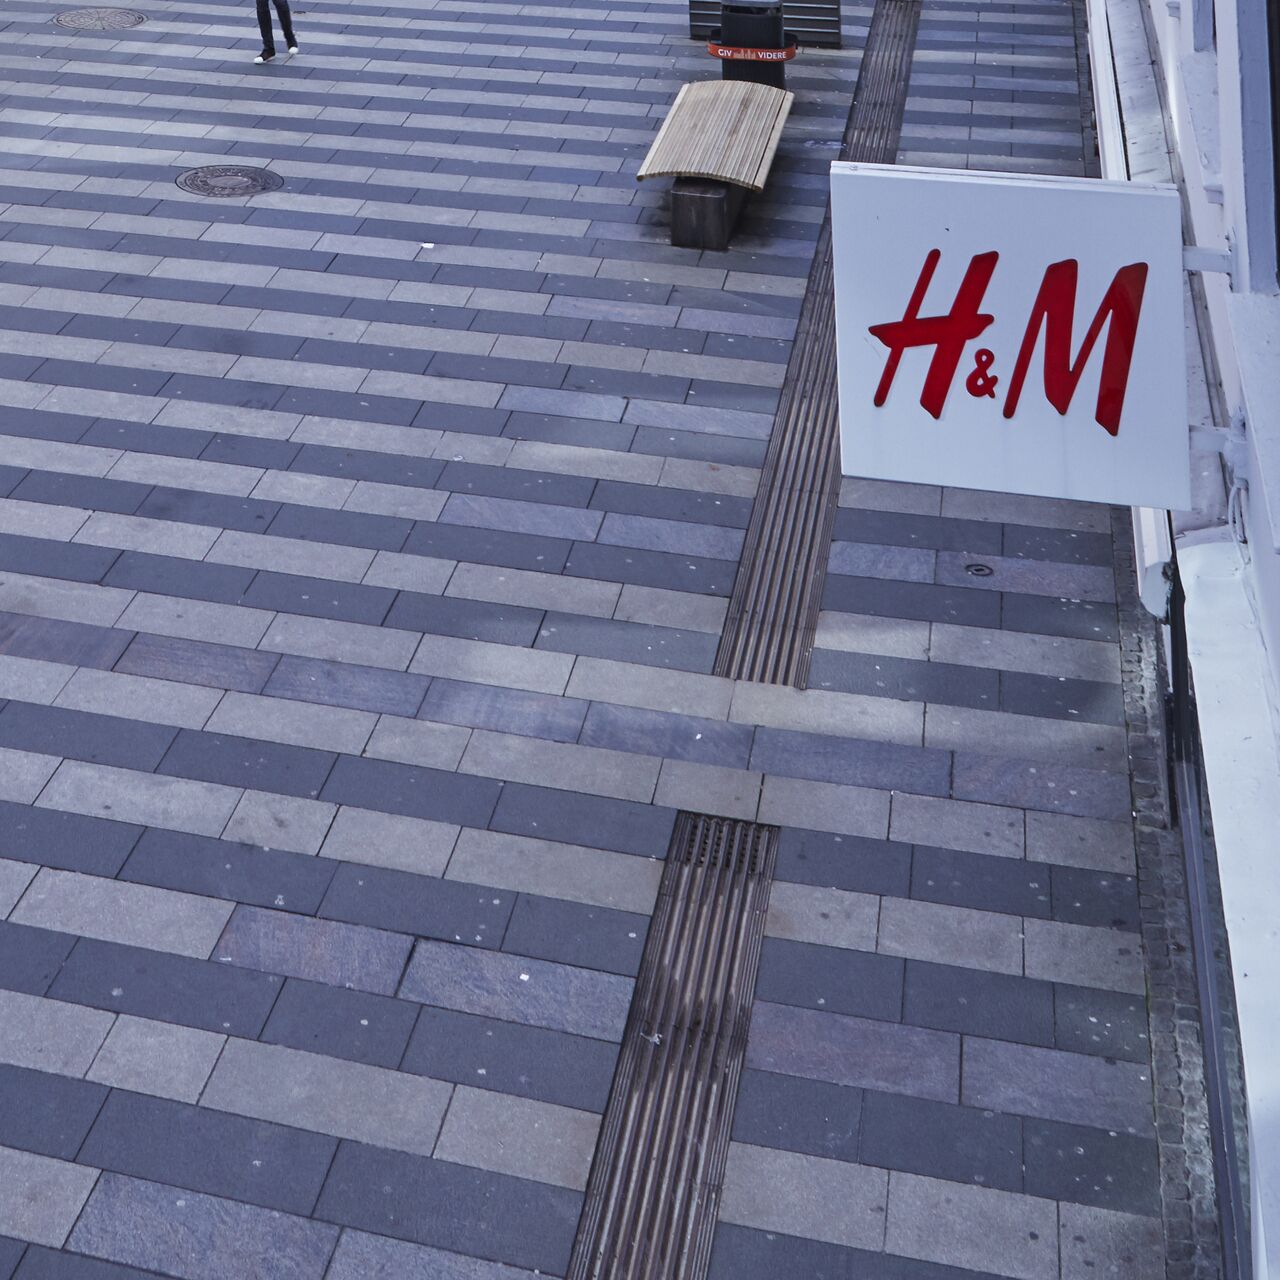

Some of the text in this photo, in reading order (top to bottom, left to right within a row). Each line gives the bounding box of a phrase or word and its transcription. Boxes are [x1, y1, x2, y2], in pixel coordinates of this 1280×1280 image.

[717, 48, 787, 59] GIV VIDERE
[867, 248, 1149, 437] H&M
